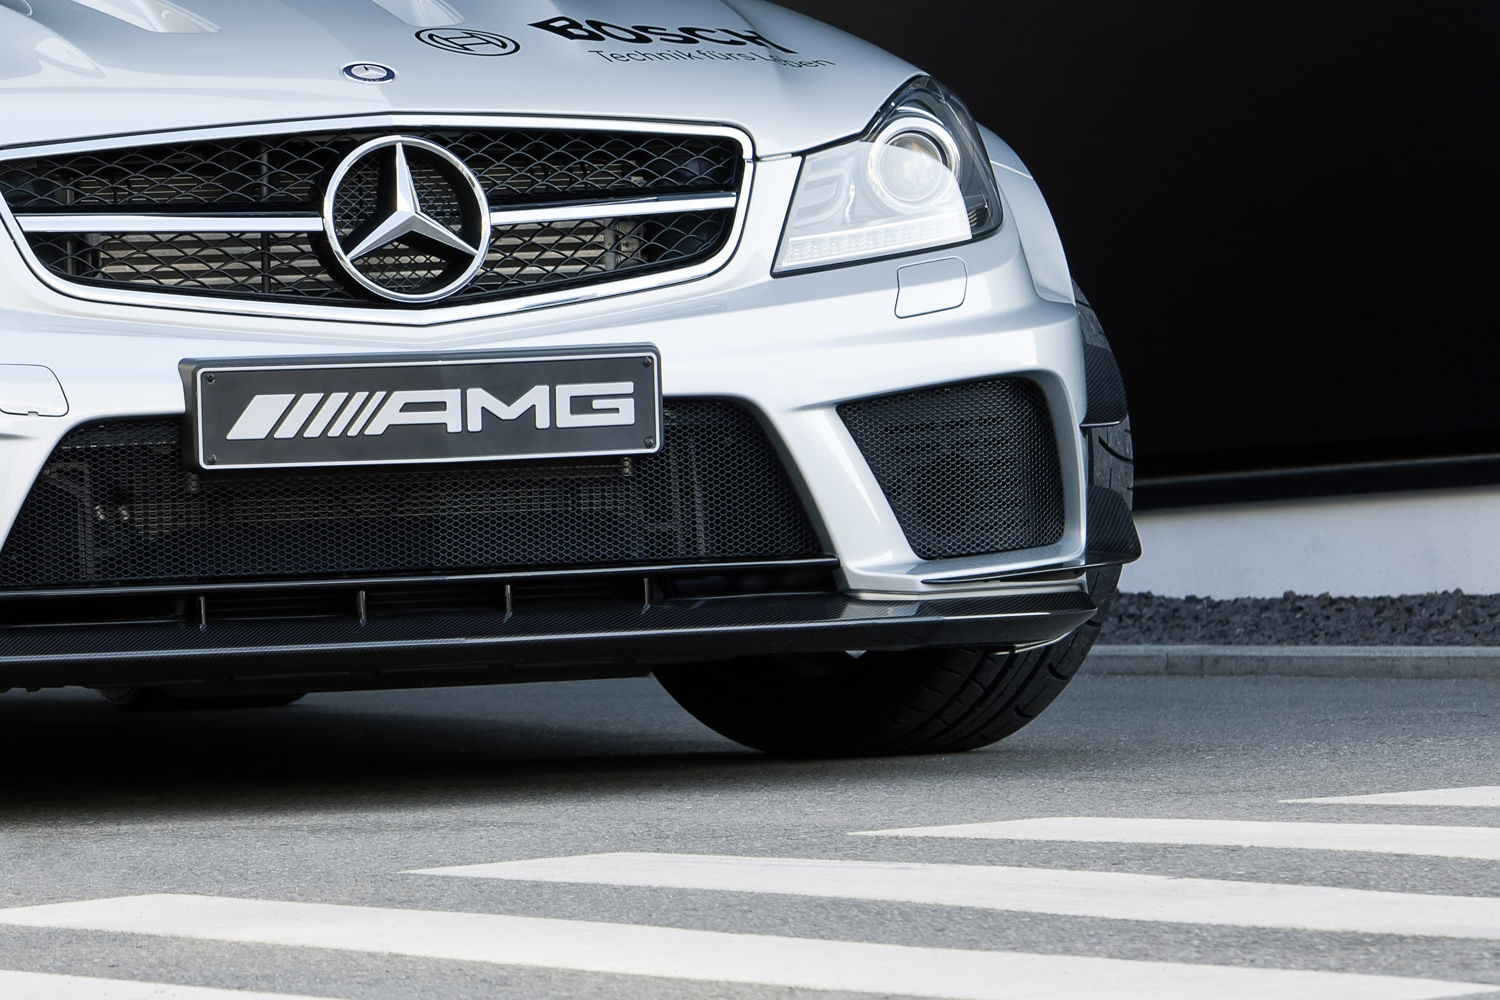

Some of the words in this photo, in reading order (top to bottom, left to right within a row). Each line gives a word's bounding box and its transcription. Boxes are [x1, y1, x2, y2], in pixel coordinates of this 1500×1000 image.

[527, 16, 798, 54] BOSCH
[588, 50, 704, 62] Technik
[363, 381, 635, 436] AMG
